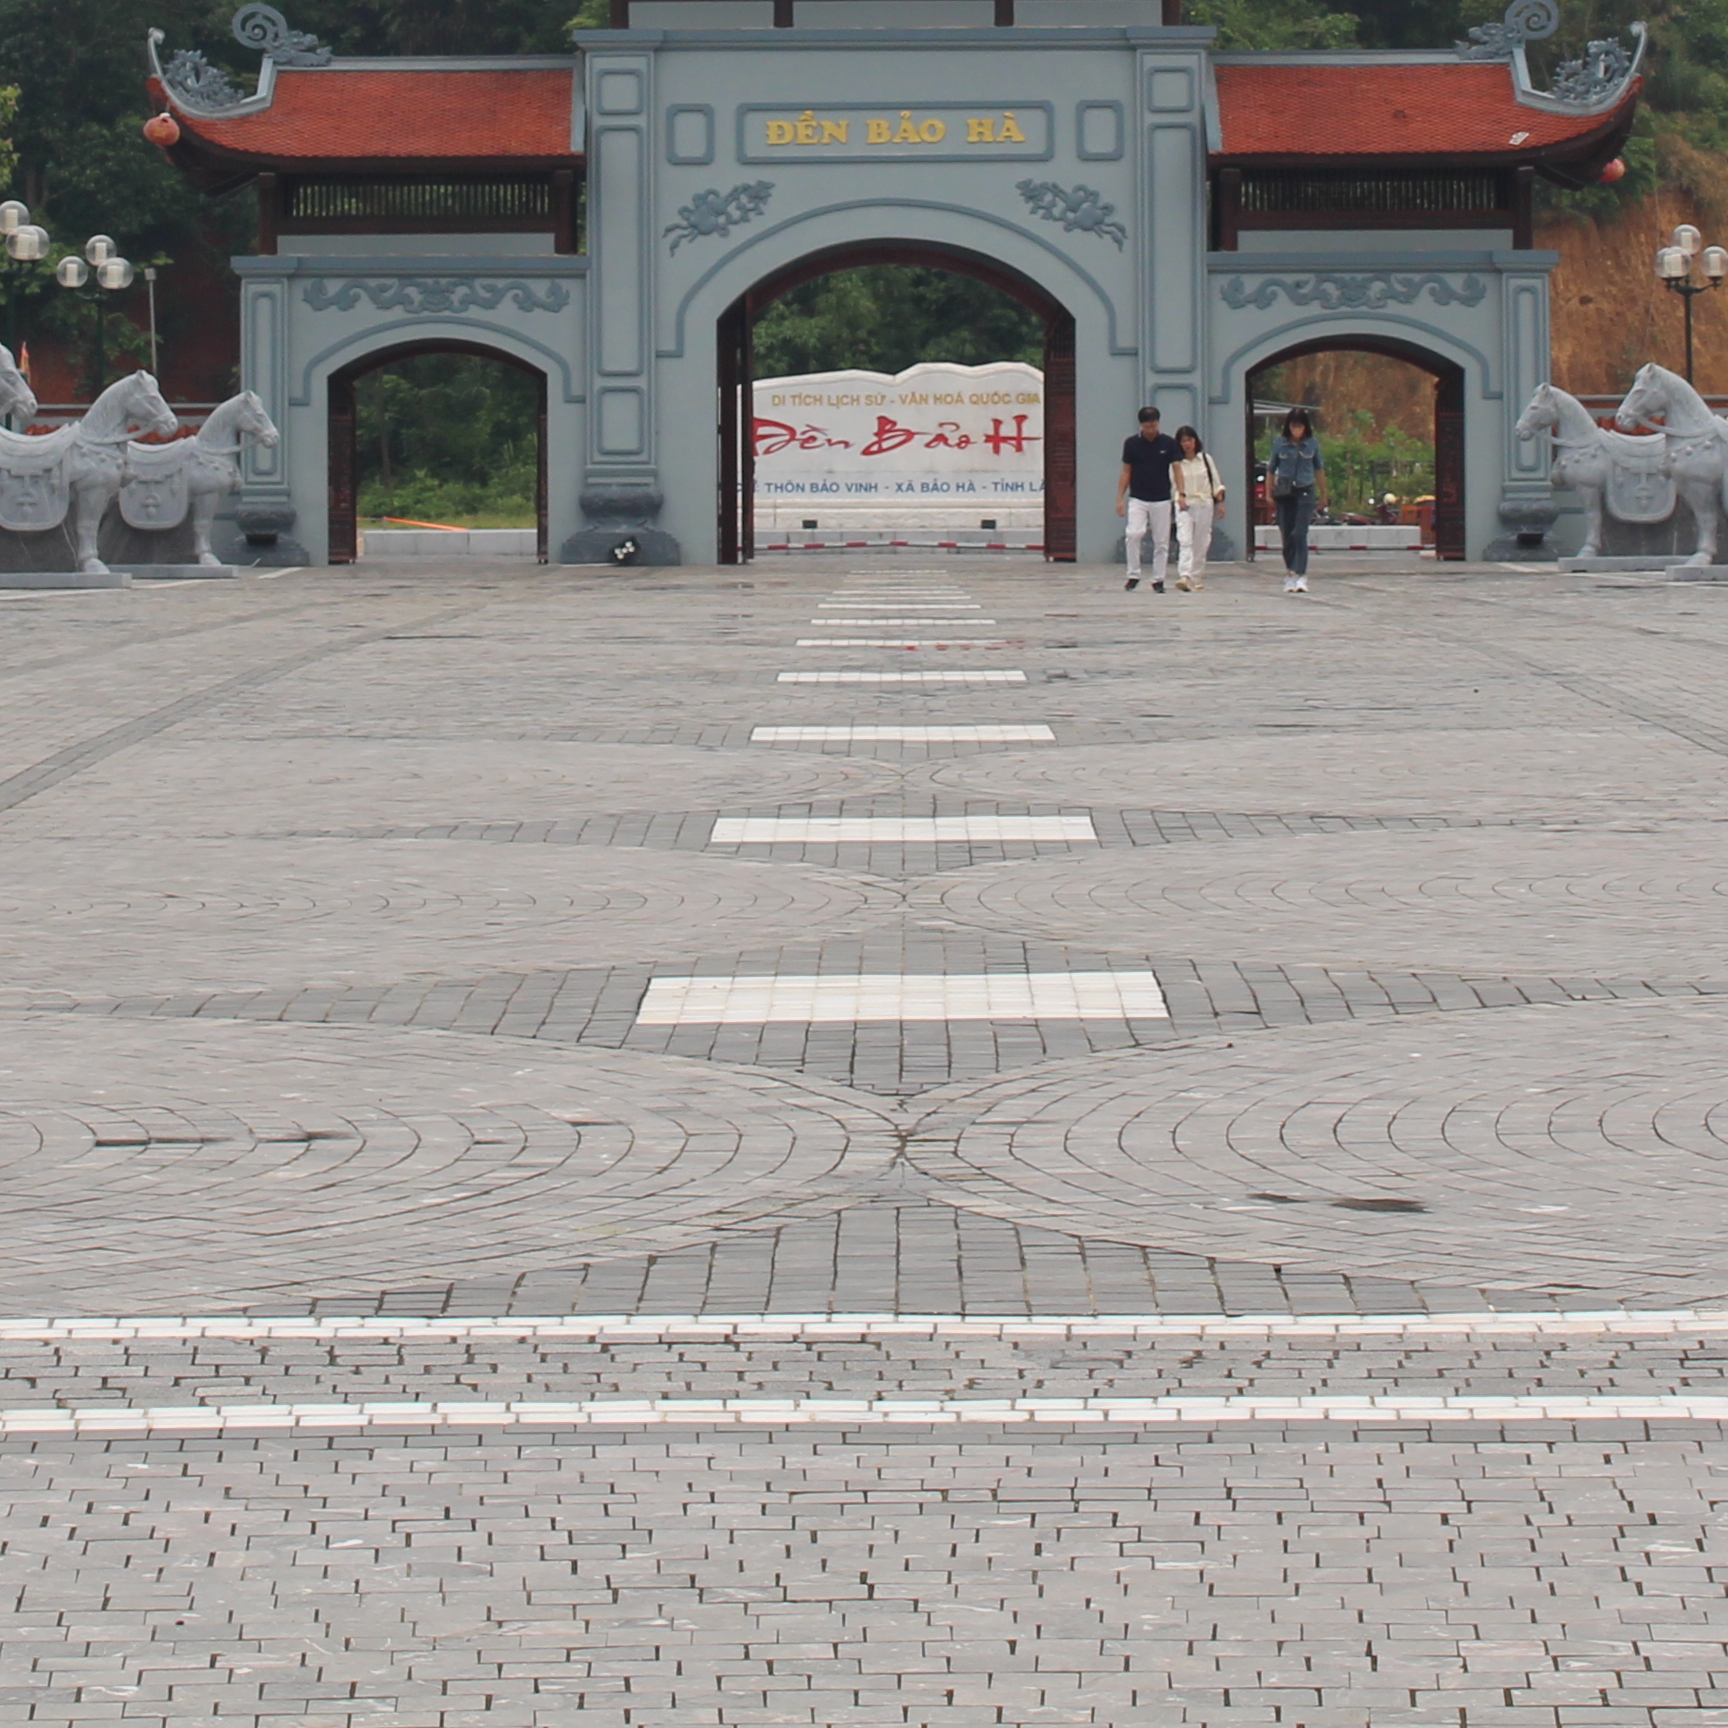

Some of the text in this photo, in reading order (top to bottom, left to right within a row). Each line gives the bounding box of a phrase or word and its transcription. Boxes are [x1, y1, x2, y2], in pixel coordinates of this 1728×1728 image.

[766, 110, 1026, 145] ĐỀN BẢO HÀ
[772, 394, 786, 407] DI
[790, 392, 823, 407] TÍCH
[827, 394, 860, 409] LỊCH
[865, 392, 887, 407] SỬ
[899, 391, 929, 405] VĂN
[933, 391, 965, 405] HOÁ
[969, 390, 1012, 405] QUỐC
[1015, 393, 1041, 405] GIA
[860, 415, 978, 456] Bảo
[764, 479, 806, 493] THÔN
[810, 478, 840, 493] BẢO
[845, 482, 878, 493] VINH
[895, 479, 915, 493] XÃ
[920, 478, 951, 493] BẢO
[955, 478, 976, 493] HÀ
[992, 478, 1025, 492] TỈNH
